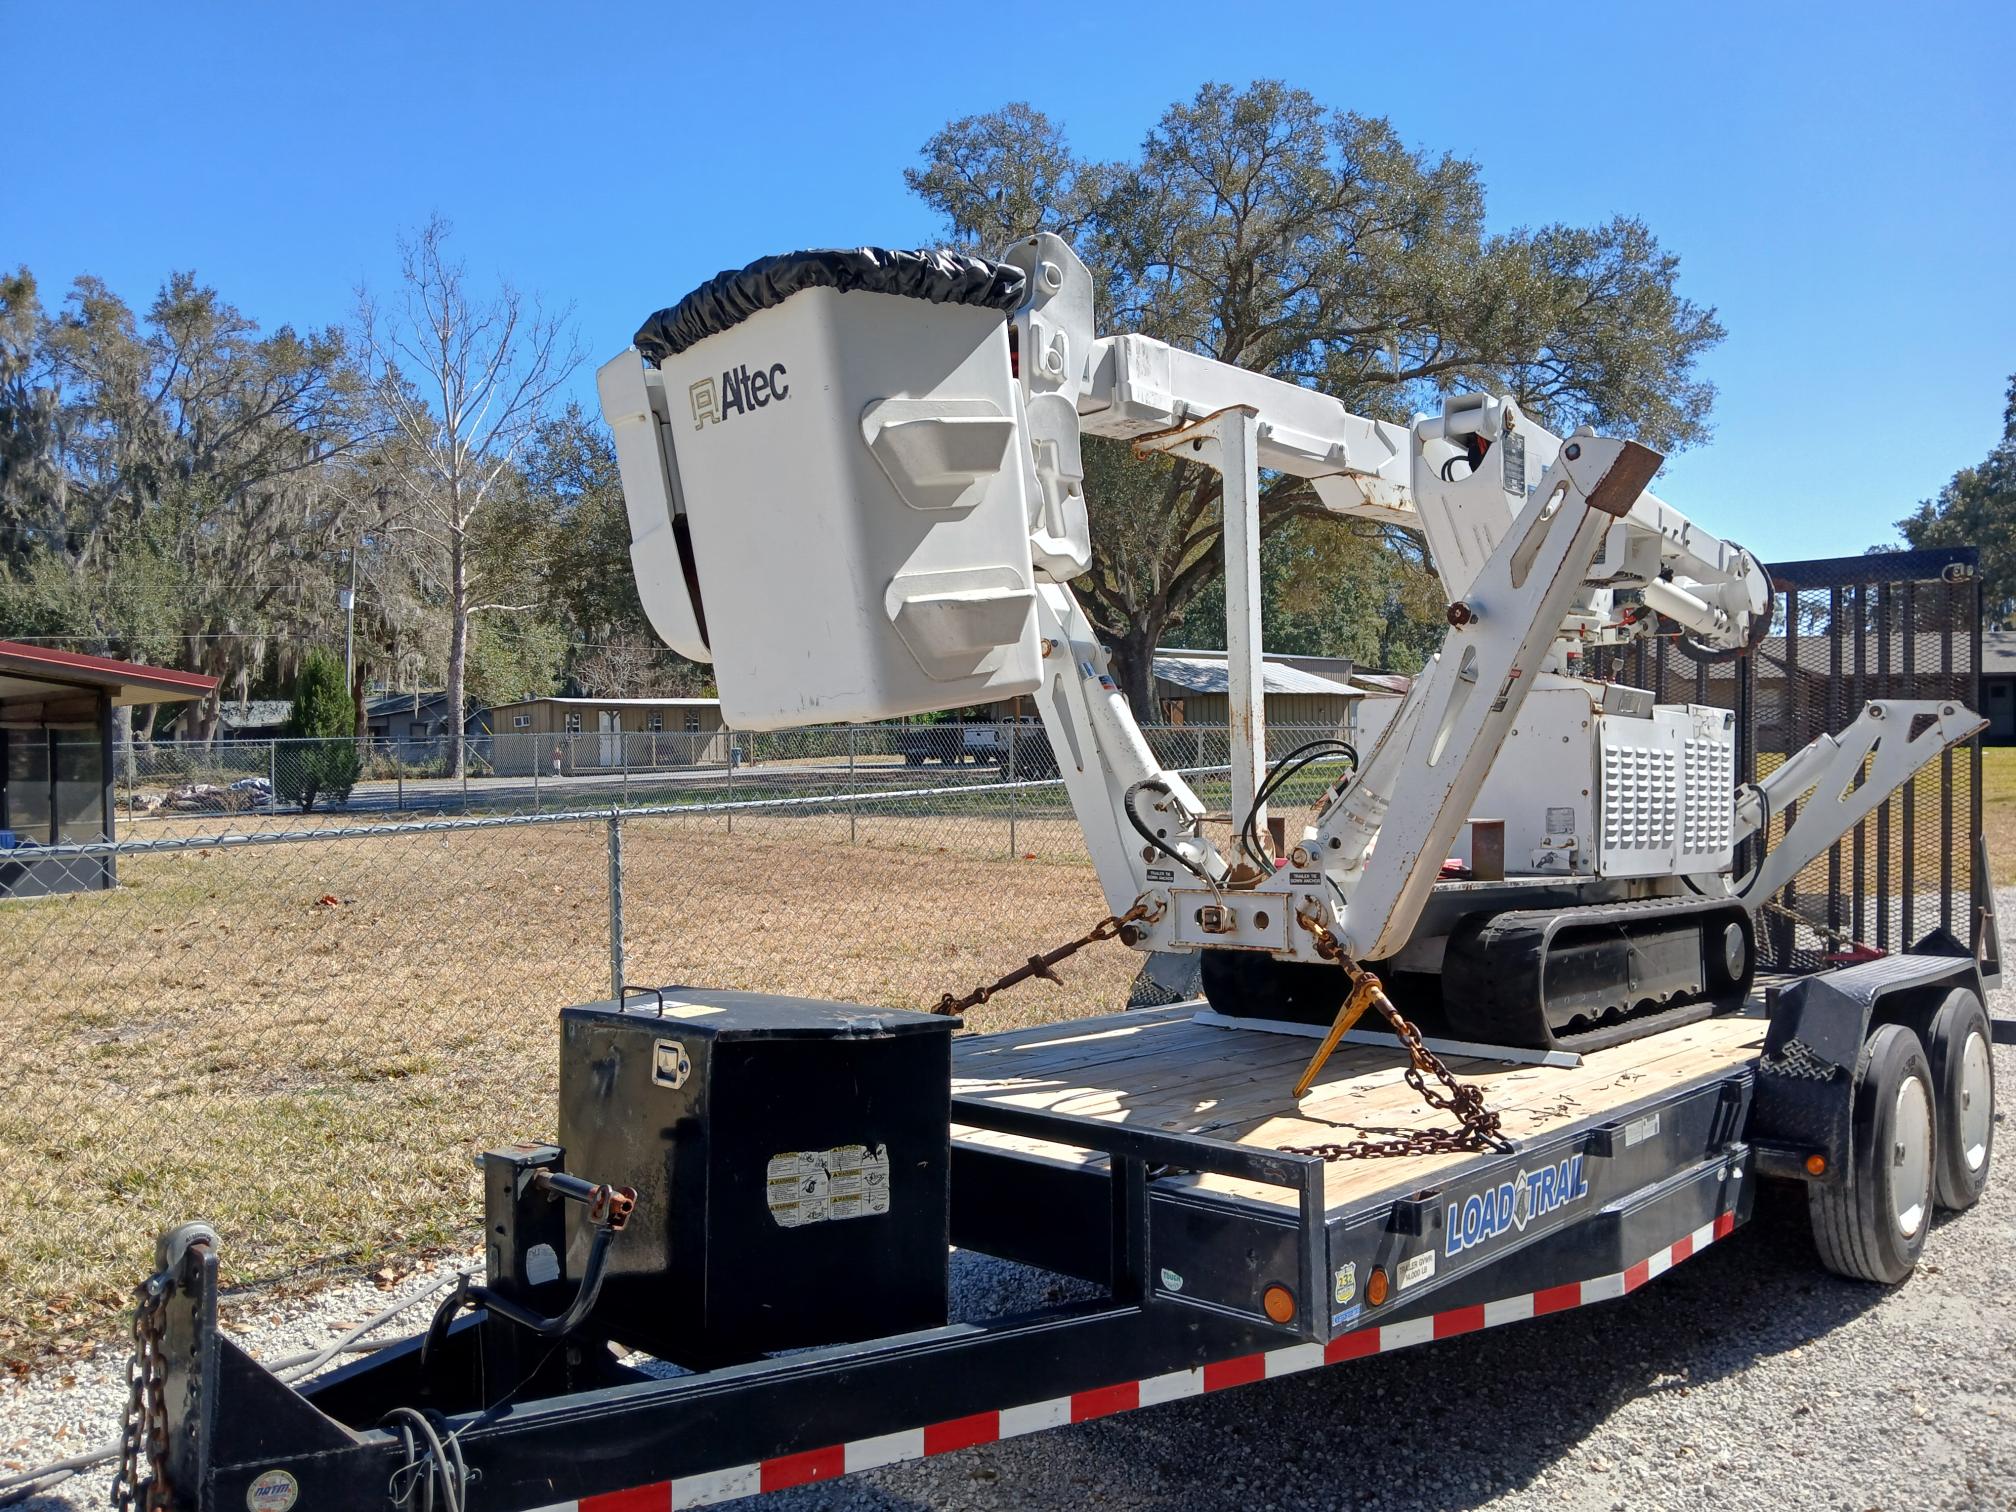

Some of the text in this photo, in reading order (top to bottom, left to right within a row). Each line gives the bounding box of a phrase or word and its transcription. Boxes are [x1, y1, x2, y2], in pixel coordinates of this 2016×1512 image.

[722, 362, 789, 421] Altec
[1445, 1153, 1589, 1258] LOAD TRAIL
[1399, 1254, 1433, 1273] TRAILER GVWR
